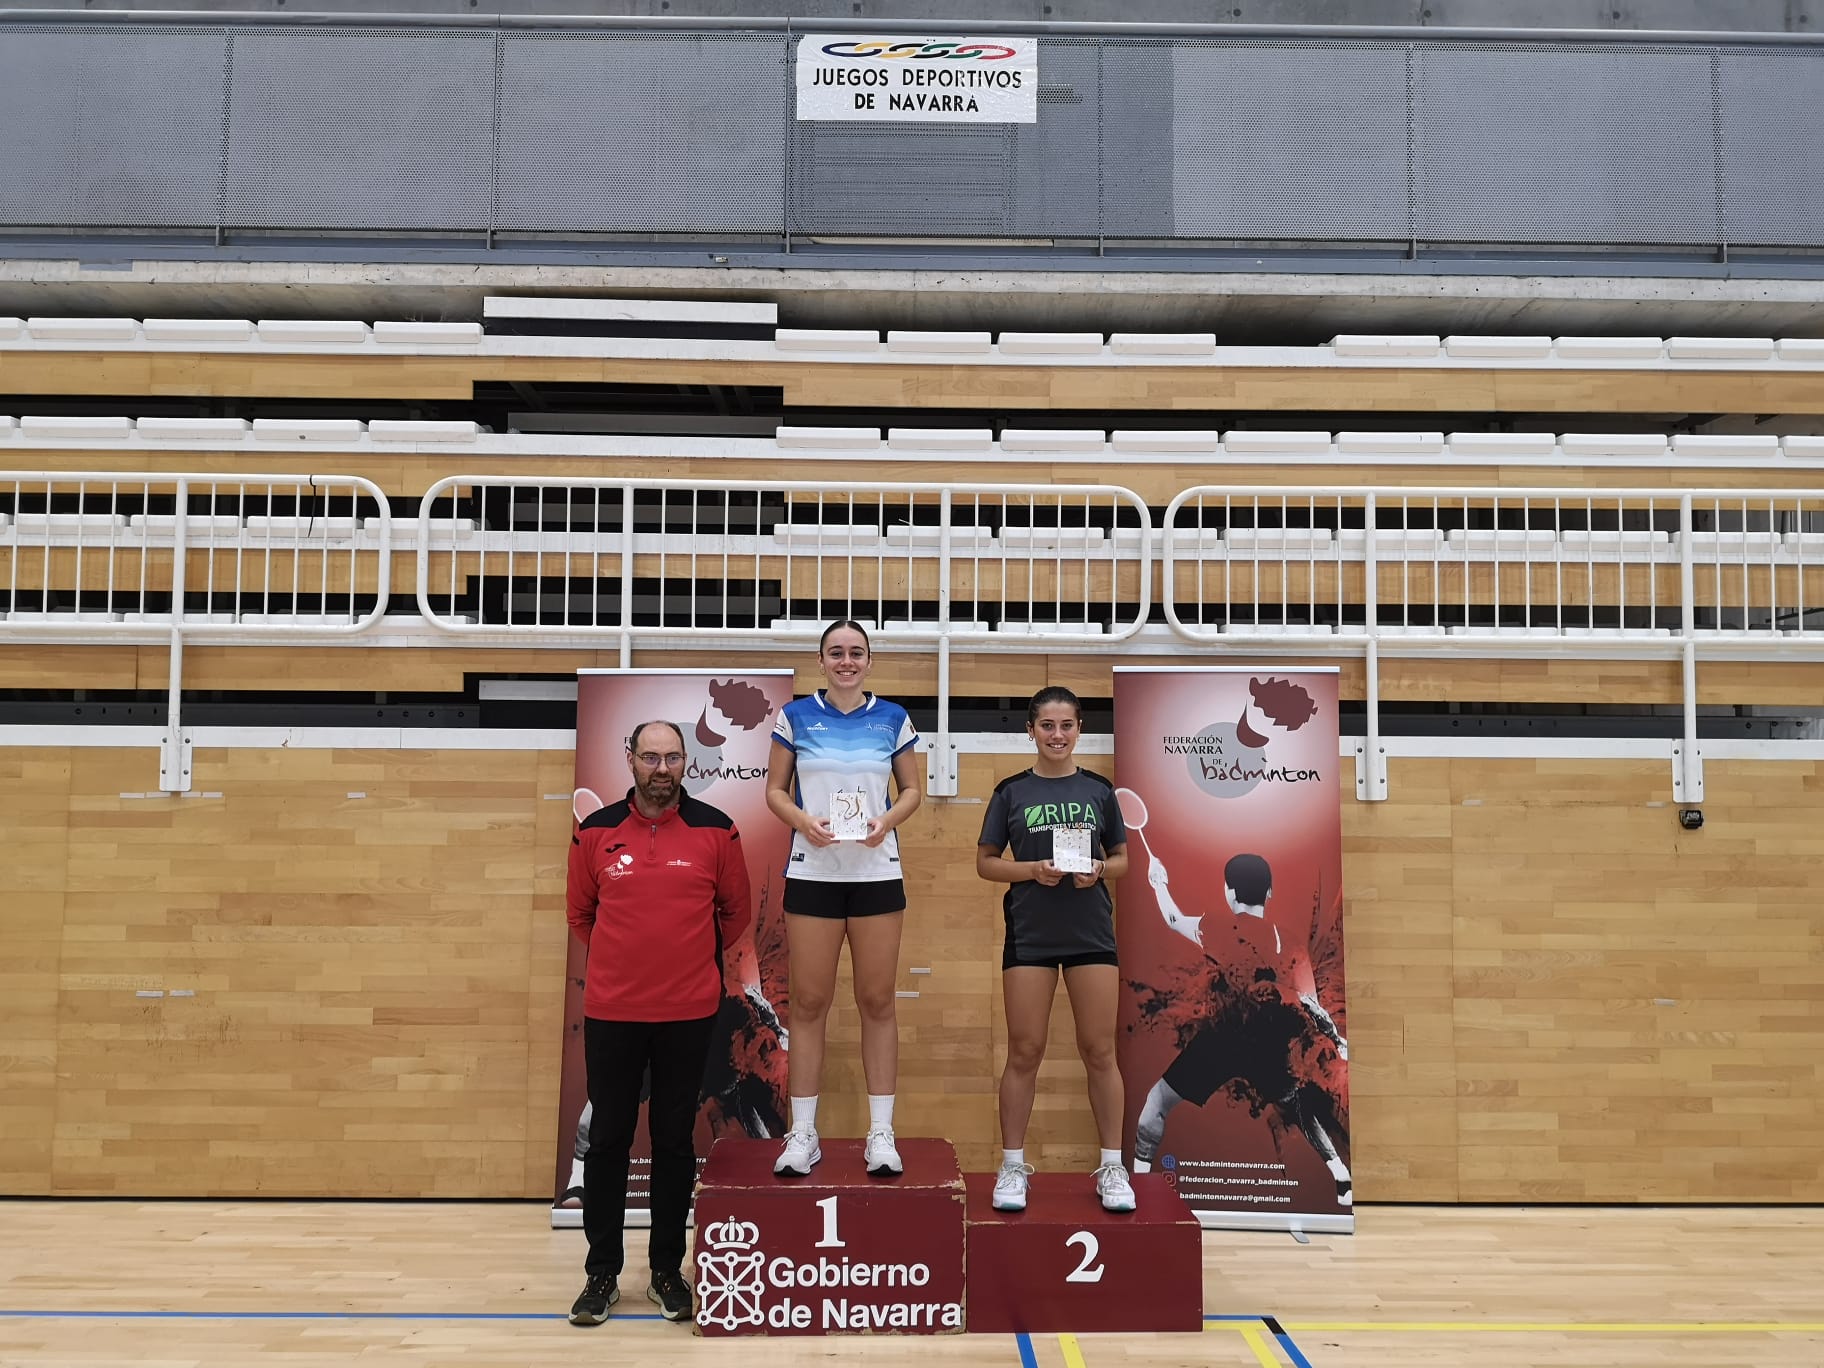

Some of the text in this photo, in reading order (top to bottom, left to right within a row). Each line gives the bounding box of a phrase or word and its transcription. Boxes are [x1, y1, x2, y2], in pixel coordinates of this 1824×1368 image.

[813, 68, 1022, 88] JUEGOS DEPORTIVOS
[854, 93, 979, 112] DE NAVARRA
[1163, 734, 1223, 745] FEDERACIÓN
[1164, 745, 1223, 755] NAVARRA
[1044, 802, 1097, 824] RIPA
[1179, 1160, 1285, 1170] www.badmintonnavarra.com
[1179, 1176, 1299, 1186] @federacion_navarra_badminton
[1179, 1192, 1291, 1204] badmintonnavarra@gmail.com
[814, 1196, 846, 1248] 1
[1065, 1230, 1105, 1283] 2
[767, 1256, 930, 1289] Gobierno
[768, 1297, 962, 1329] de Navarra
